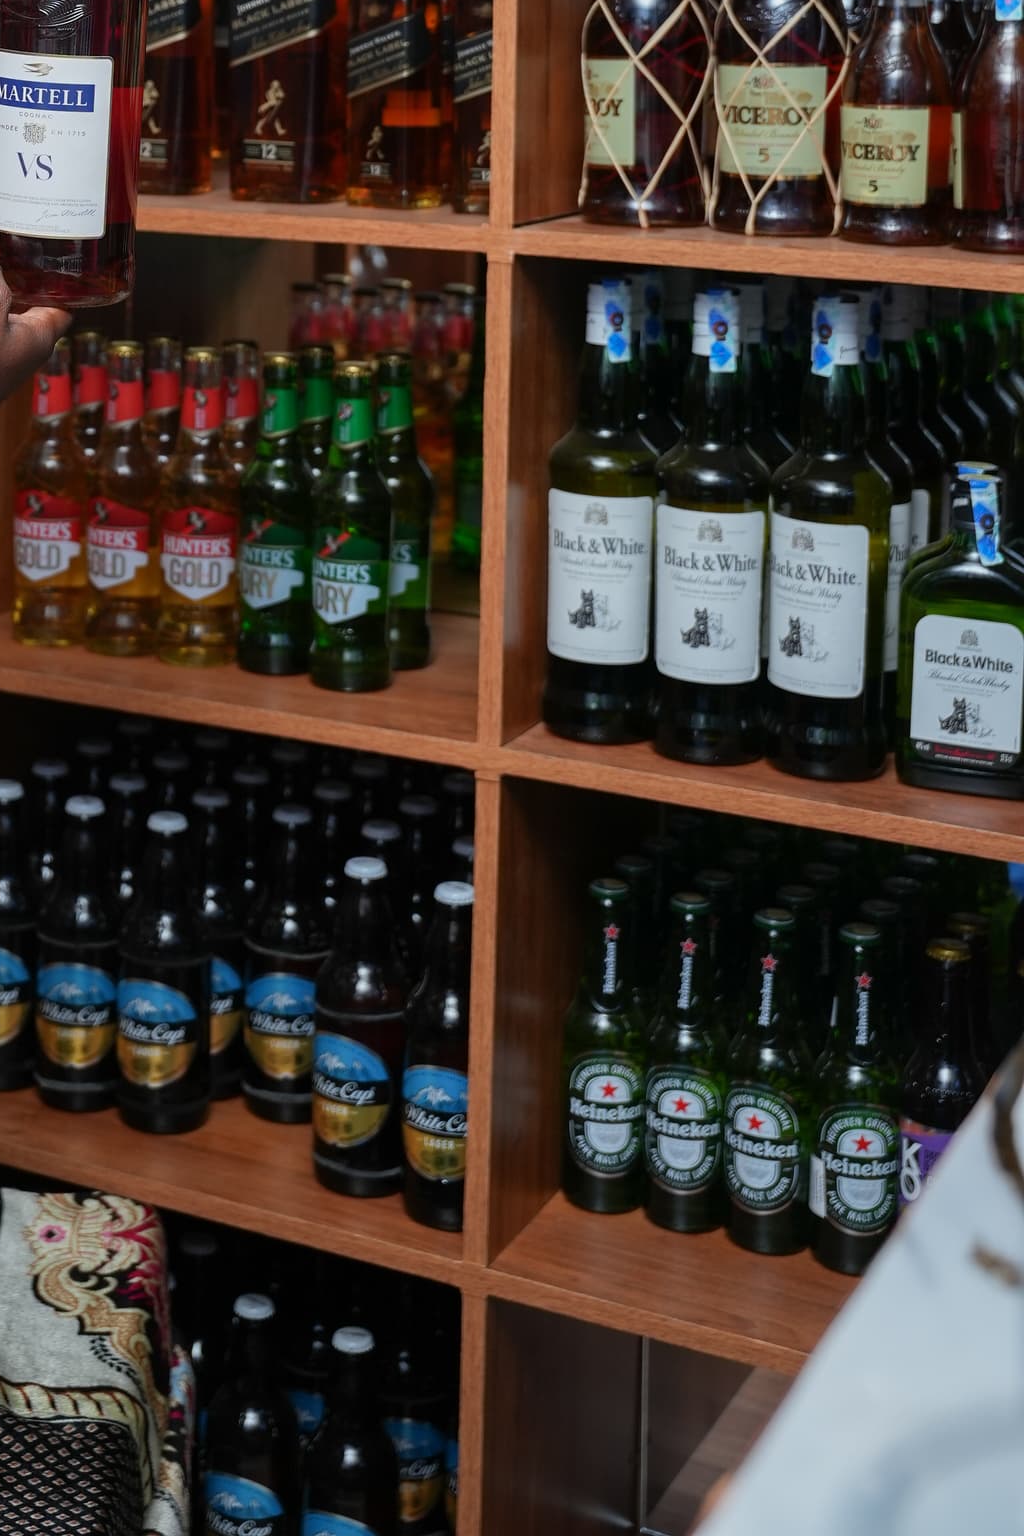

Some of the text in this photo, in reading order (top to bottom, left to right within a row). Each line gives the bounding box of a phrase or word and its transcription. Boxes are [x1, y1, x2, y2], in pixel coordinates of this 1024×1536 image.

[19, 110, 55, 120] COGNAC
[721, 103, 818, 128] VICEROY
[141, 142, 152, 156] 2
[261, 142, 277, 160] 12
[758, 147, 770, 163] 5
[841, 142, 921, 163] VICEROY
[17, 152, 54, 181] VS
[868, 179, 879, 193] 5
[16, 520, 71, 540] UNTER'S
[88, 527, 138, 550] NTER'S
[164, 535, 231, 556] HUNTER'S
[553, 529, 584, 554] Black
[601, 536, 645, 555] White
[89, 547, 126, 578] OLD
[243, 546, 296, 568] NTER'S
[663, 546, 702, 570] Black
[716, 553, 757, 573] White
[169, 557, 223, 588] GOLD
[808, 563, 856, 585] White
[314, 582, 353, 615] DRY
[865, 1117, 896, 1147] ORIGINAL
[846, 1210, 873, 1223] MALT
